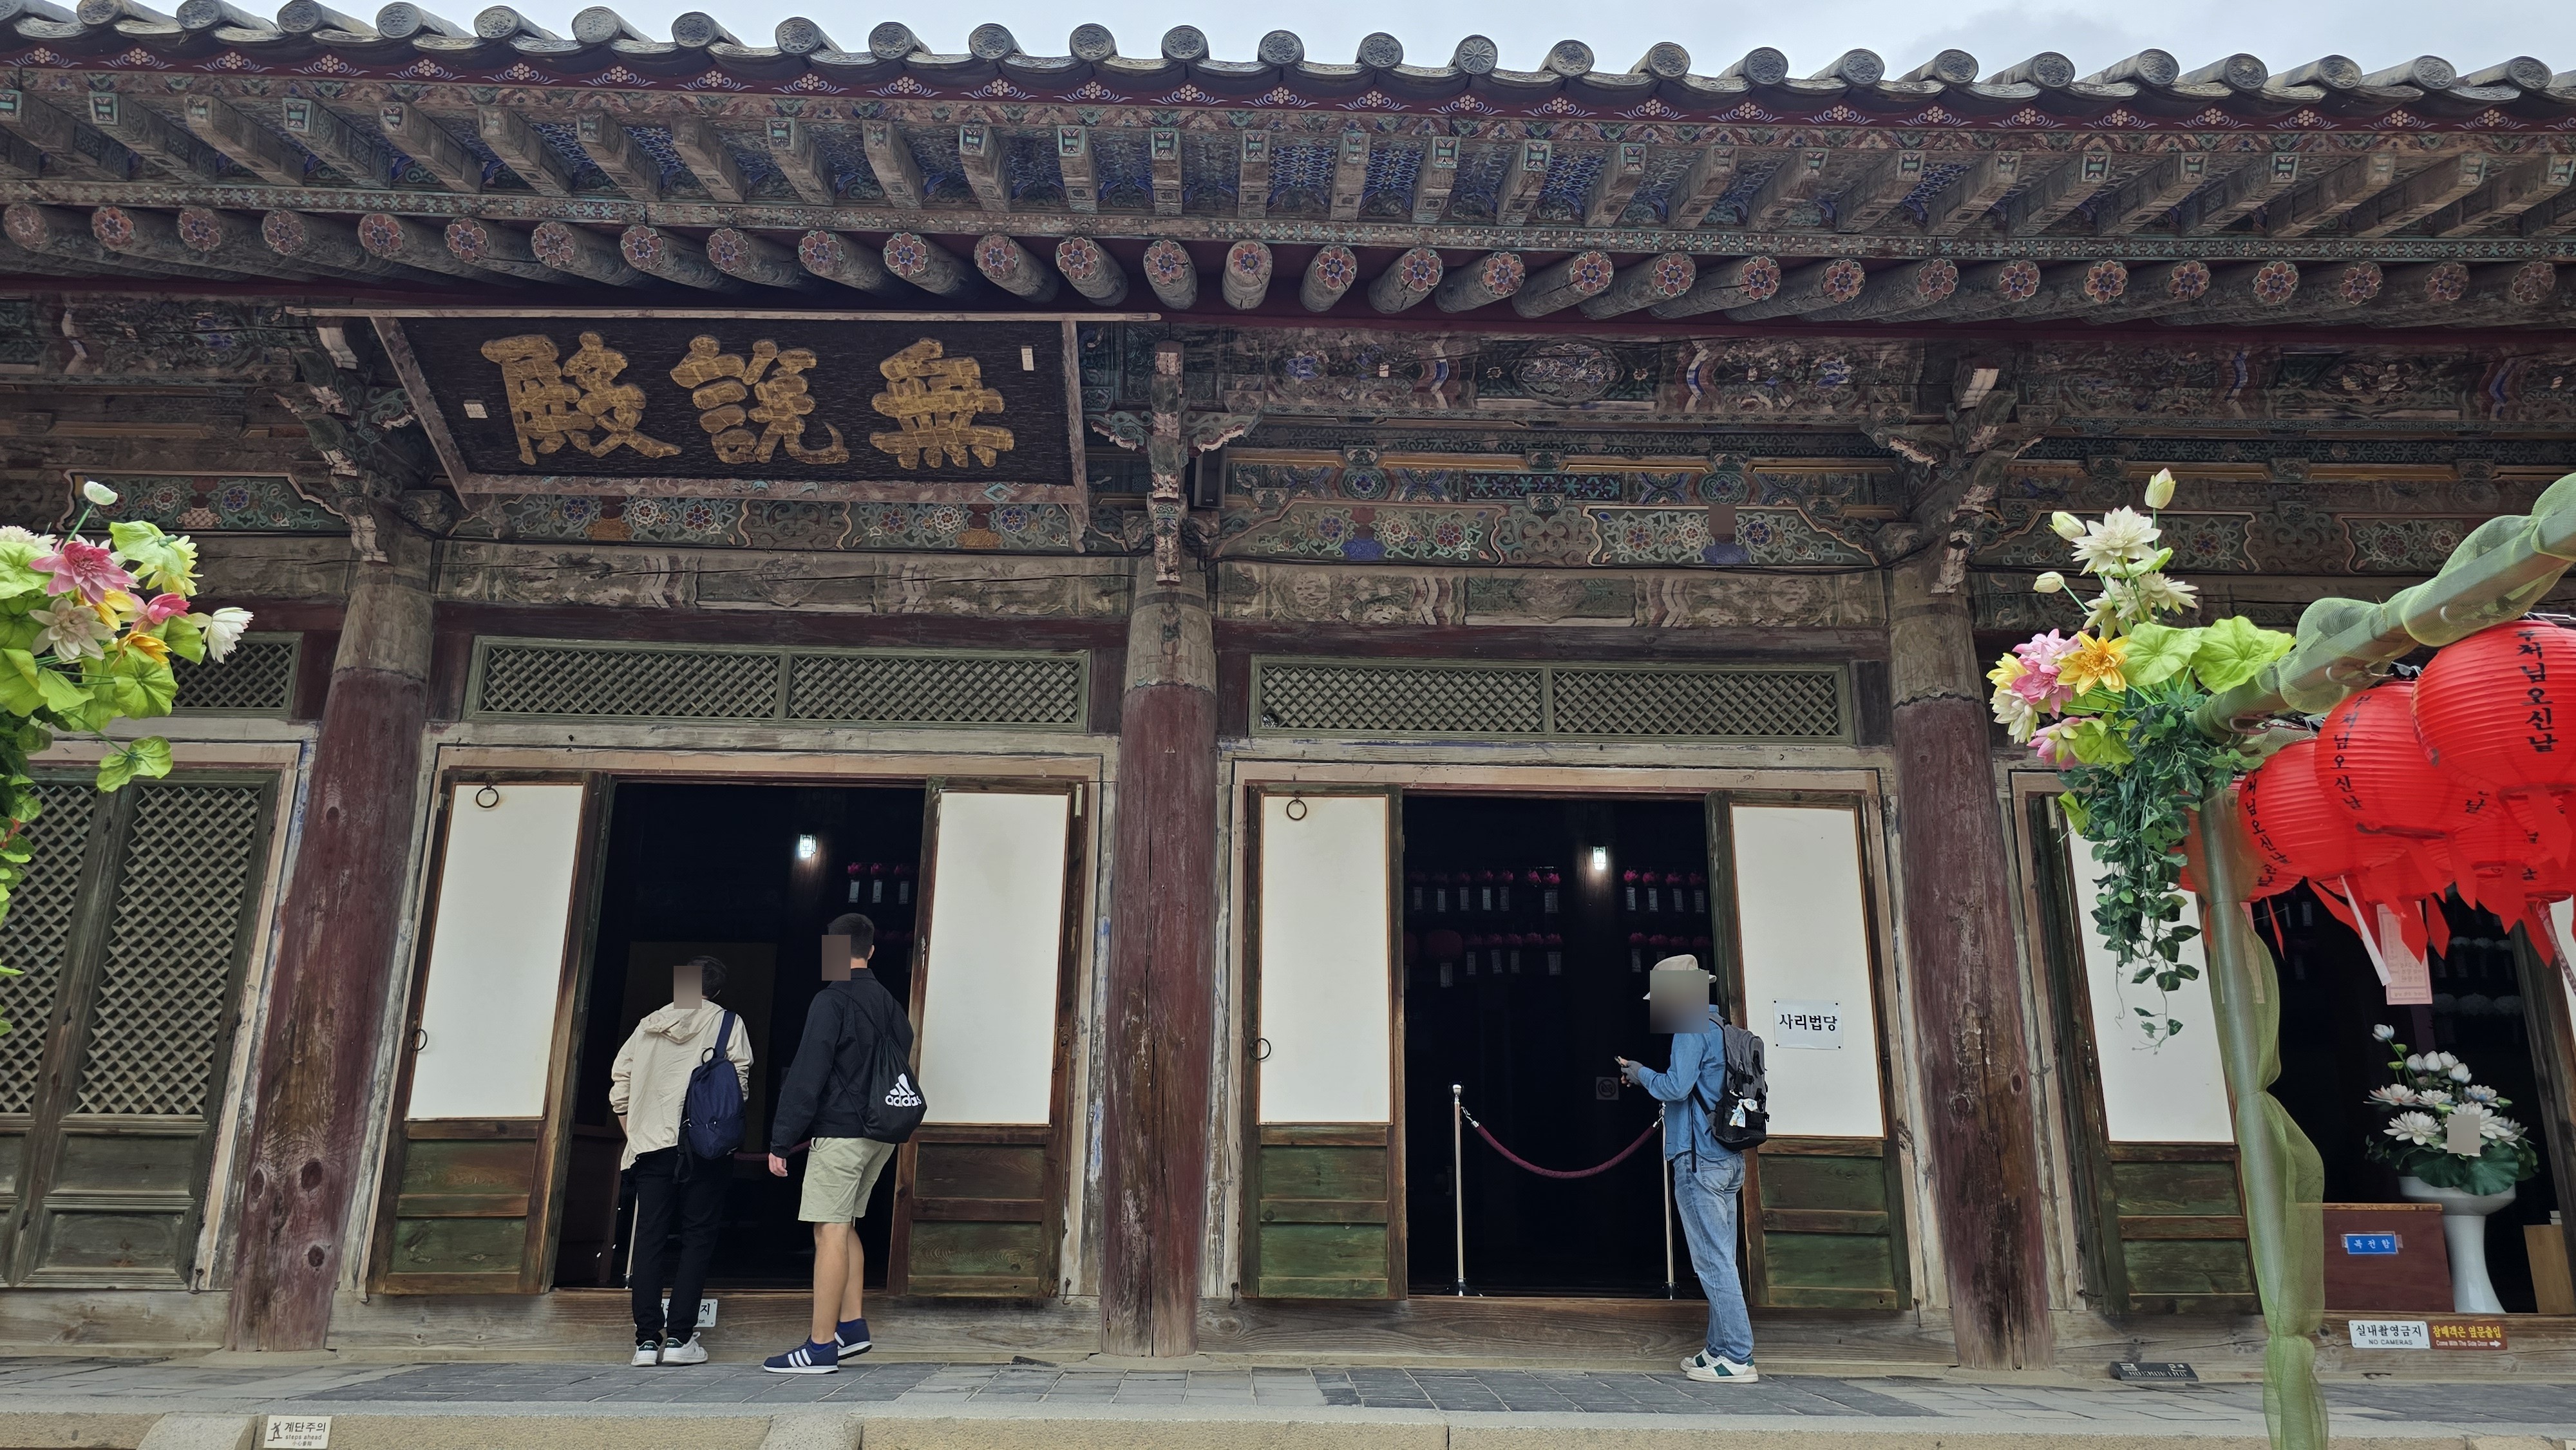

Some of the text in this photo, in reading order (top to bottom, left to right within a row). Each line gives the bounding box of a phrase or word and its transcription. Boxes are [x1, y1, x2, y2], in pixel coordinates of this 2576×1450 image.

[1779, 1013, 1837, 1031] 사리법당
[2356, 1324, 2422, 1337] 실내촬영금지
[2432, 1324, 2501, 1339] 참배객은 옆문출입
[285, 1422, 327, 1433] 계단주의
